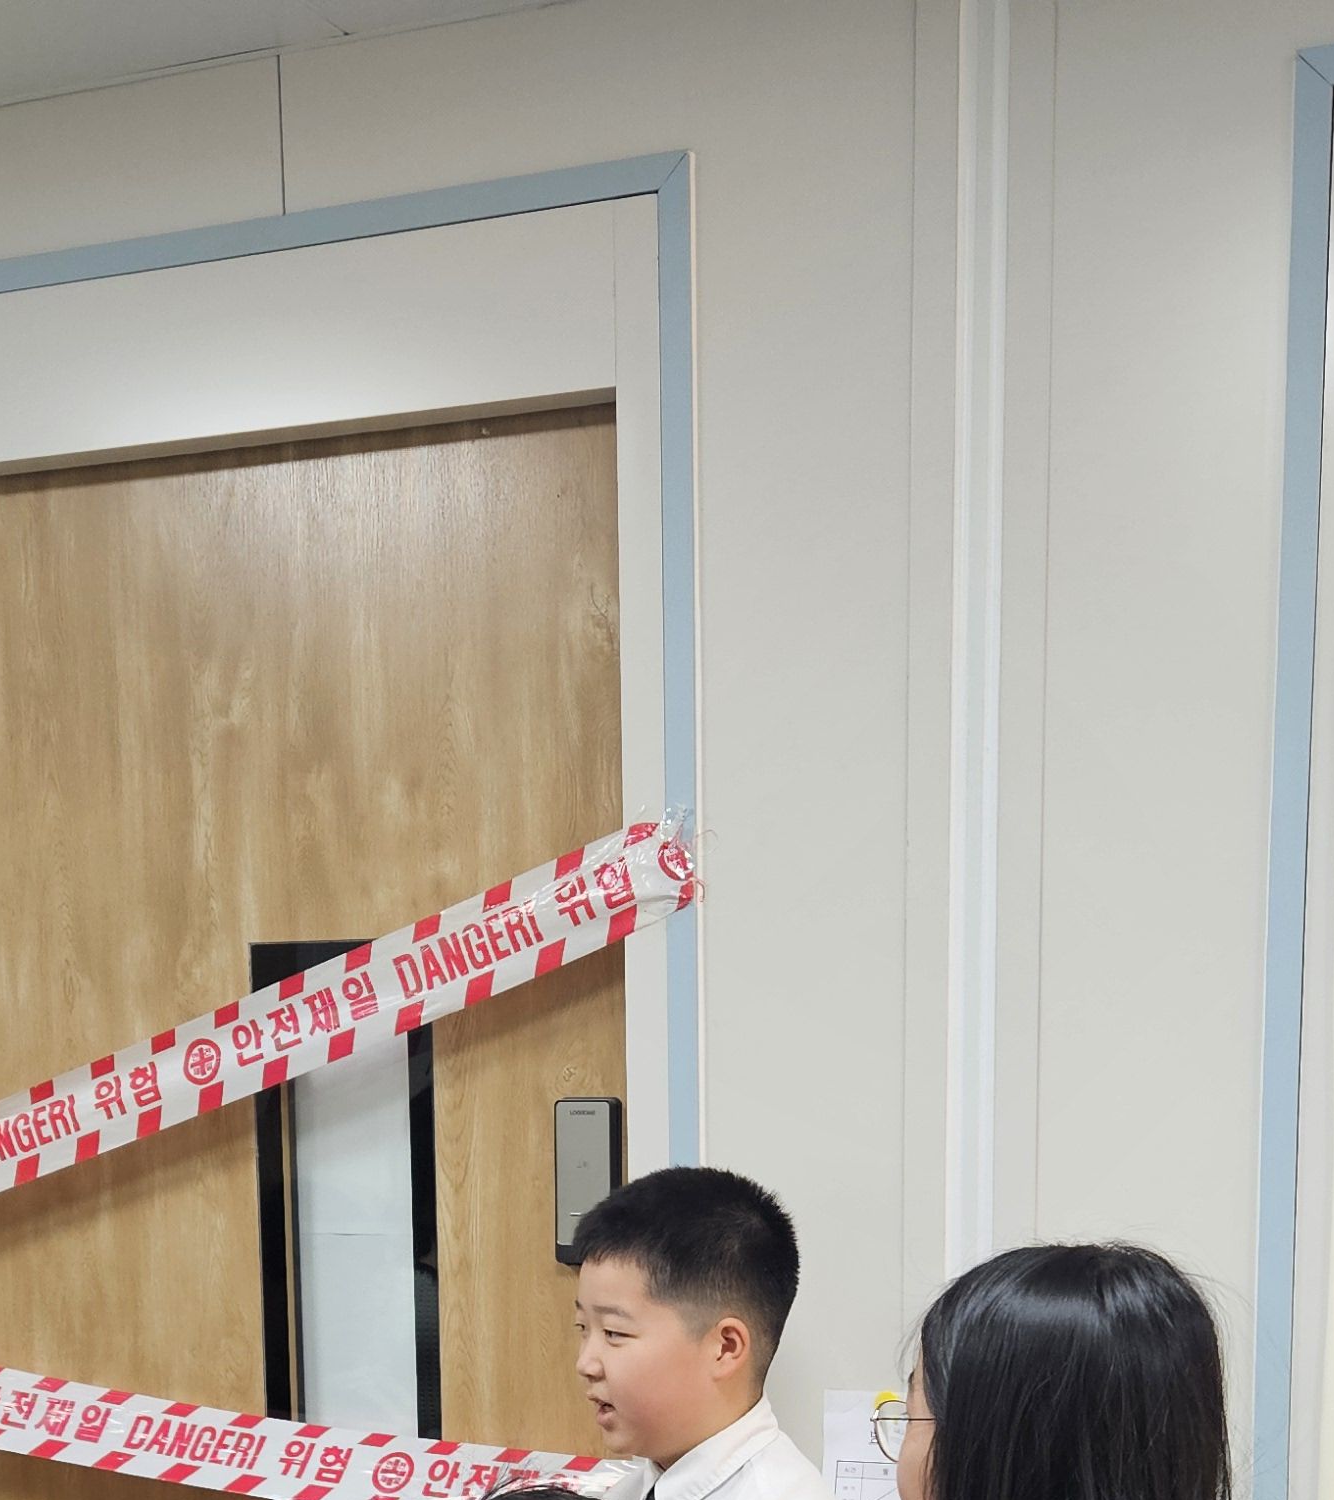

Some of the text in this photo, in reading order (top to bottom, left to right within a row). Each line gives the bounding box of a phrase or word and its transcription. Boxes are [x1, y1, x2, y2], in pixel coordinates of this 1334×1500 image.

[94, 1062, 163, 1120] 위험
[232, 972, 379, 1067] 안전제일
[393, 907, 543, 998] DANGER!
[555, 857, 636, 927] 위험
[123, 1415, 265, 1470] DANGER!
[278, 1440, 353, 1484] 위험
